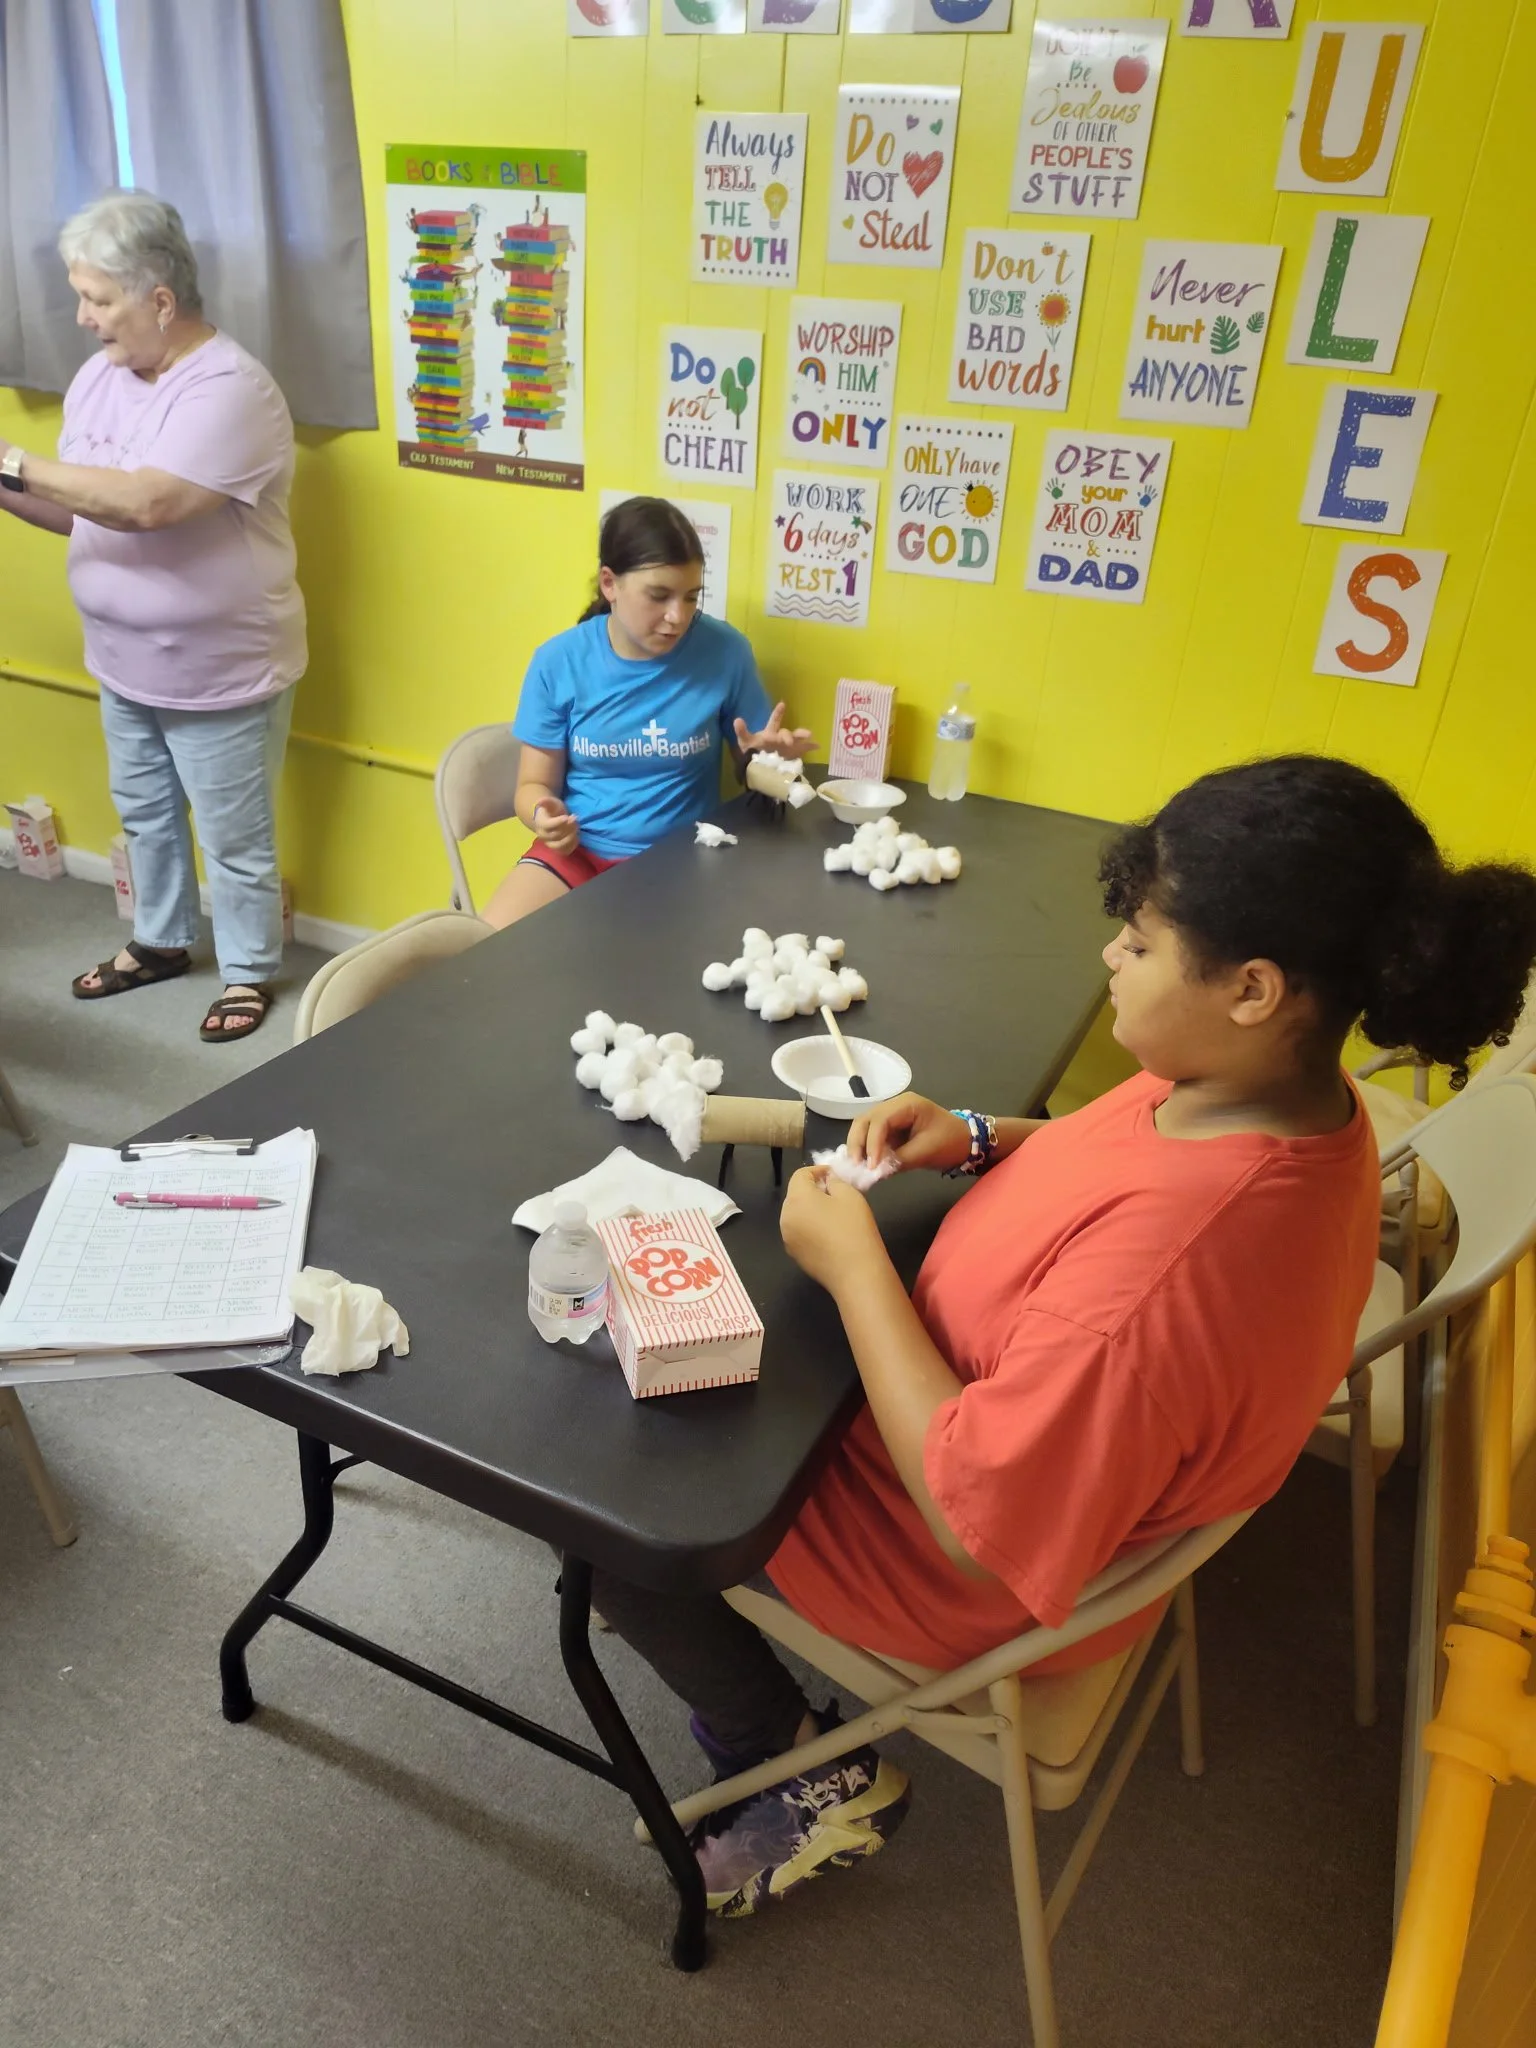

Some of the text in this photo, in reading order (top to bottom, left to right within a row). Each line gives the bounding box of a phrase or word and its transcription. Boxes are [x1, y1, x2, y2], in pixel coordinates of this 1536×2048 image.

[1069, 59, 1092, 82] Be
[1031, 86, 1141, 127] Jealous
[705, 119, 795, 175] Always
[847, 112, 896, 167] Do
[1053, 120, 1118, 143] OF OTHER
[405, 157, 474, 184] BOOKS
[500, 162, 563, 187] BIBLE
[1030, 144, 1133, 170] PEOPLE'S
[704, 164, 756, 192] TELL
[845, 170, 900, 203] NOT
[1022, 172, 1132, 208] STUFF
[704, 200, 752, 227] THE
[859, 208, 933, 252] Steal
[700, 234, 789, 265] TRUTH
[973, 240, 1075, 285] Don't
[1150, 258, 1265, 307] Never
[968, 287, 1026, 318] USE
[797, 321, 895, 358] WORSHIP
[966, 322, 1026, 354] BAD
[1146, 315, 1205, 344] hurt
[670, 342, 716, 385] Do
[837, 362, 879, 393] HIM
[1129, 356, 1248, 407] ANYONE
[667, 388, 720, 421] not
[792, 410, 887, 450] ONLY
[410, 451, 475, 471] OLD TESTAMENT
[664, 433, 748, 474] CHEAT
[904, 441, 1001, 476] ONLY have
[1055, 444, 1161, 483] OBEY
[495, 464, 568, 483] NEW TESTAMENT
[786, 482, 866, 514] WORK
[900, 484, 959, 519] ONE
[1081, 485, 1128, 505] your
[784, 512, 860, 555] 6 days
[1045, 503, 1143, 541] MOM
[897, 522, 990, 568] GOD
[1086, 540, 1101, 557] &
[779, 560, 859, 597] REST 1
[1038, 554, 1139, 591] DAD
[841, 714, 870, 733] POP
[844, 730, 879, 749] CORN
[573, 731, 711, 760] Allensville Baptist
[628, 1218, 674, 1243] fresh
[627, 1247, 689, 1279] POP
[646, 1257, 722, 1297] CORN
[640, 1306, 711, 1328] DELICIOUS
[713, 1315, 752, 1332] CRISP
